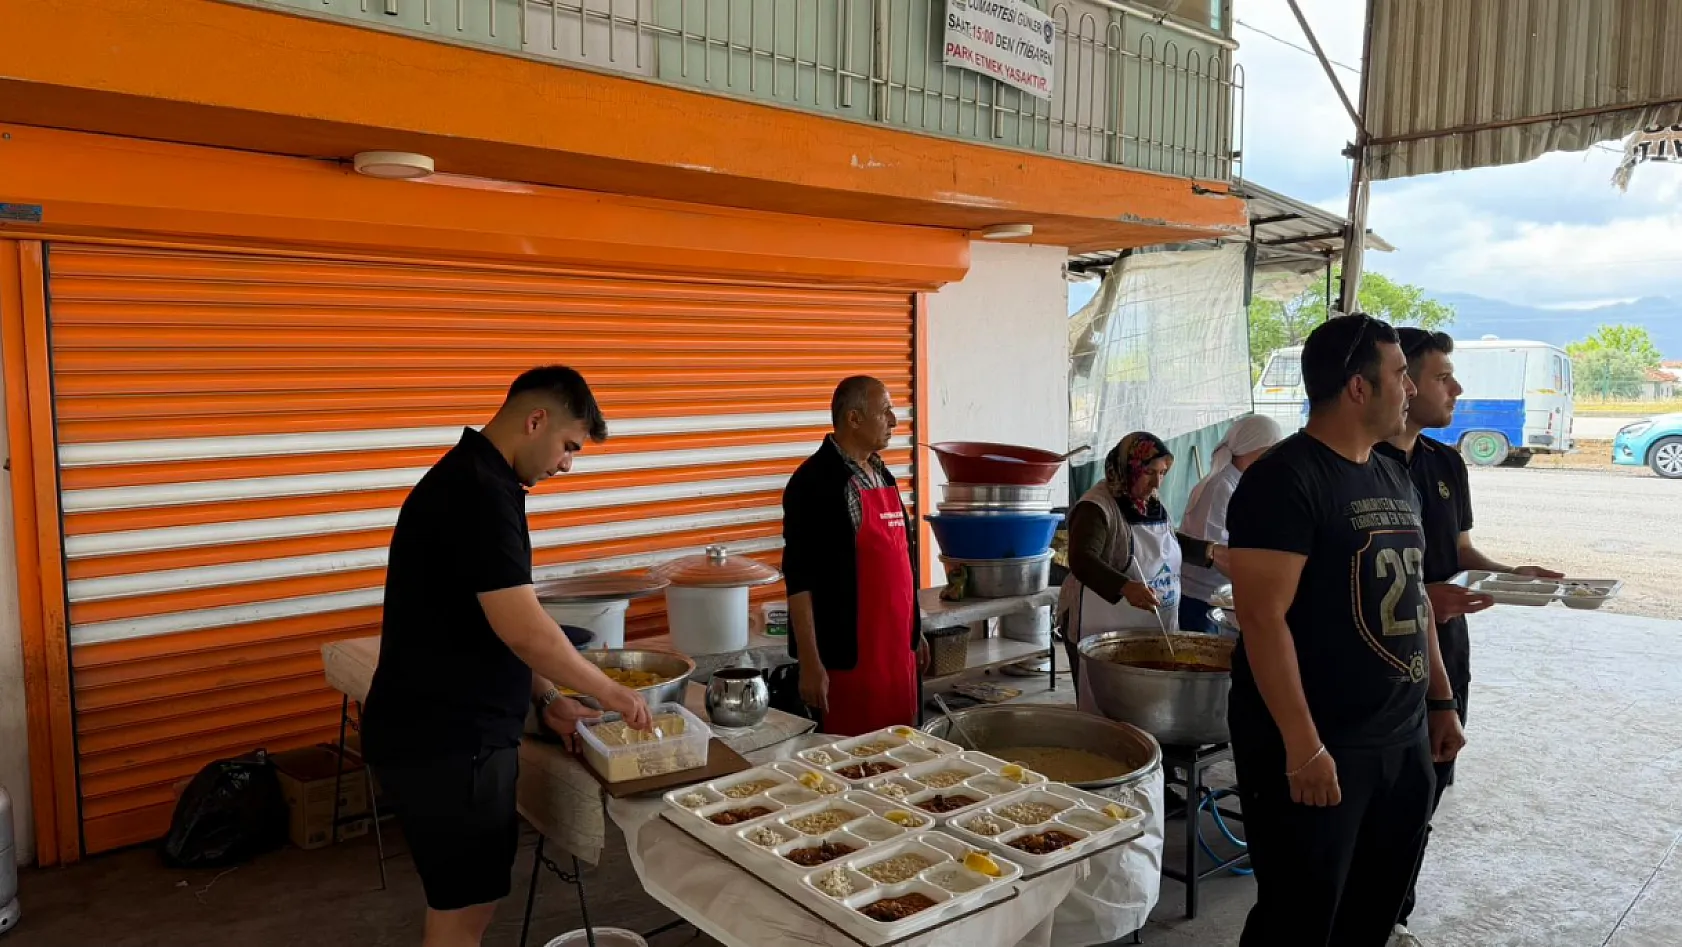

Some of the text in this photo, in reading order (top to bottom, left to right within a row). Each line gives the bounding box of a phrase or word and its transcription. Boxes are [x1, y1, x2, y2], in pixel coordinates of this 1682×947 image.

[946, 43, 974, 61] PARK
[975, 53, 1004, 75] ETMEK
[996, 33, 1015, 52] DEN
[1016, 37, 1053, 66] İTİBAREN
